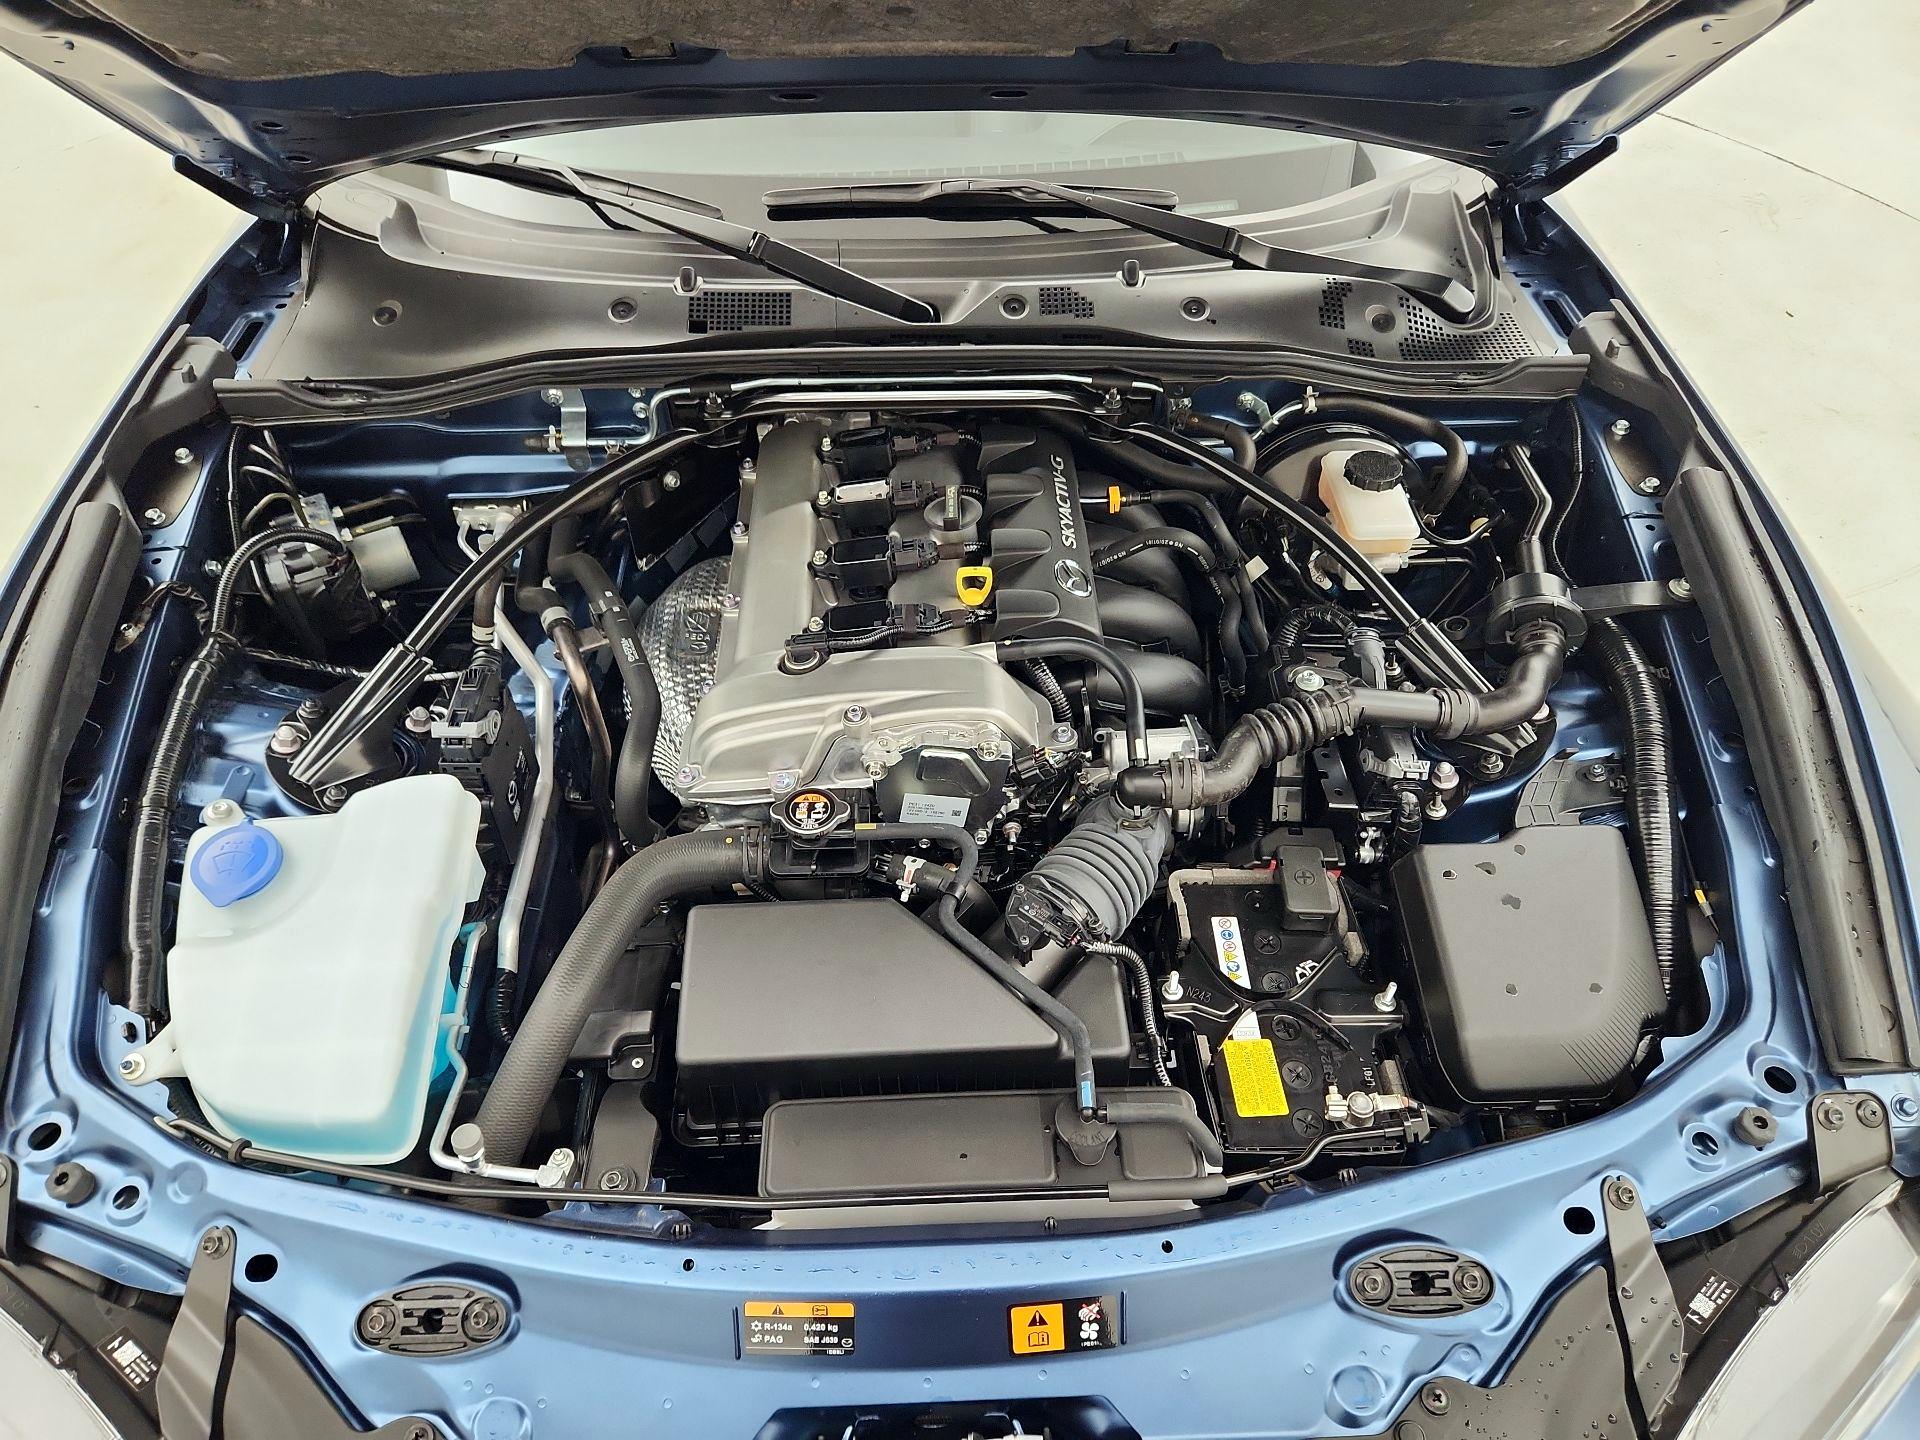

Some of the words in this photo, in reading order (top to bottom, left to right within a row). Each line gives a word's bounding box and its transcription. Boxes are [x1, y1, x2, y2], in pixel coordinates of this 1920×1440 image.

[1051, 454, 1077, 549] SKYACTIV-G
[1186, 986, 1212, 1003] N243
[764, 1323, 793, 1331] R-134a
[803, 1323, 826, 1331] 0.420
[828, 1323, 839, 1333] kg
[764, 1336, 784, 1344] PAG
